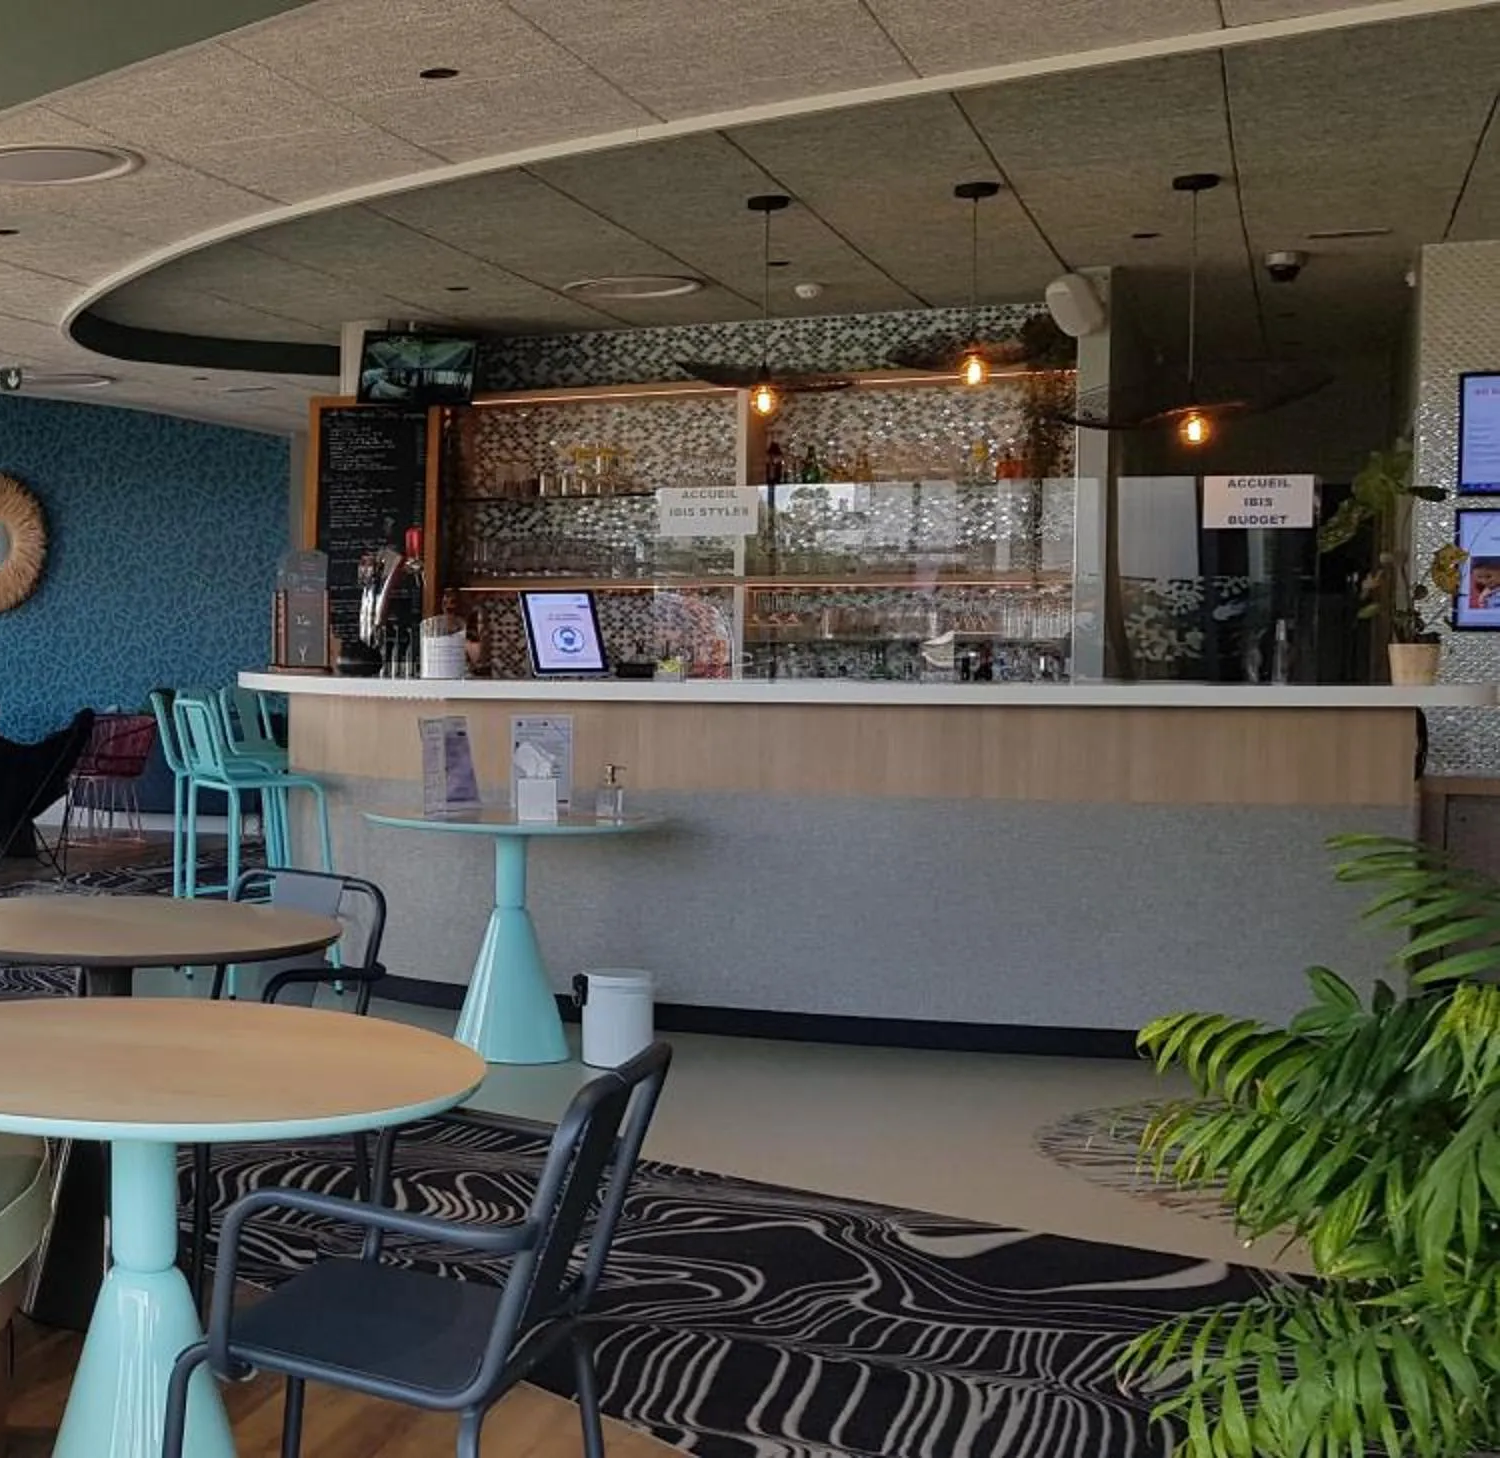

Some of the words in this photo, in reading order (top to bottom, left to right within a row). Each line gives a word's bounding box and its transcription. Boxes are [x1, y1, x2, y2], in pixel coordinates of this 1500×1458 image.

[1227, 478, 1292, 489] ACCUEIL
[681, 489, 740, 499] ACCUEIL
[1243, 497, 1273, 507] IBIS
[668, 507, 695, 517] IBIS
[699, 507, 749, 517] STYLES
[1227, 514, 1288, 525] BUDGET
